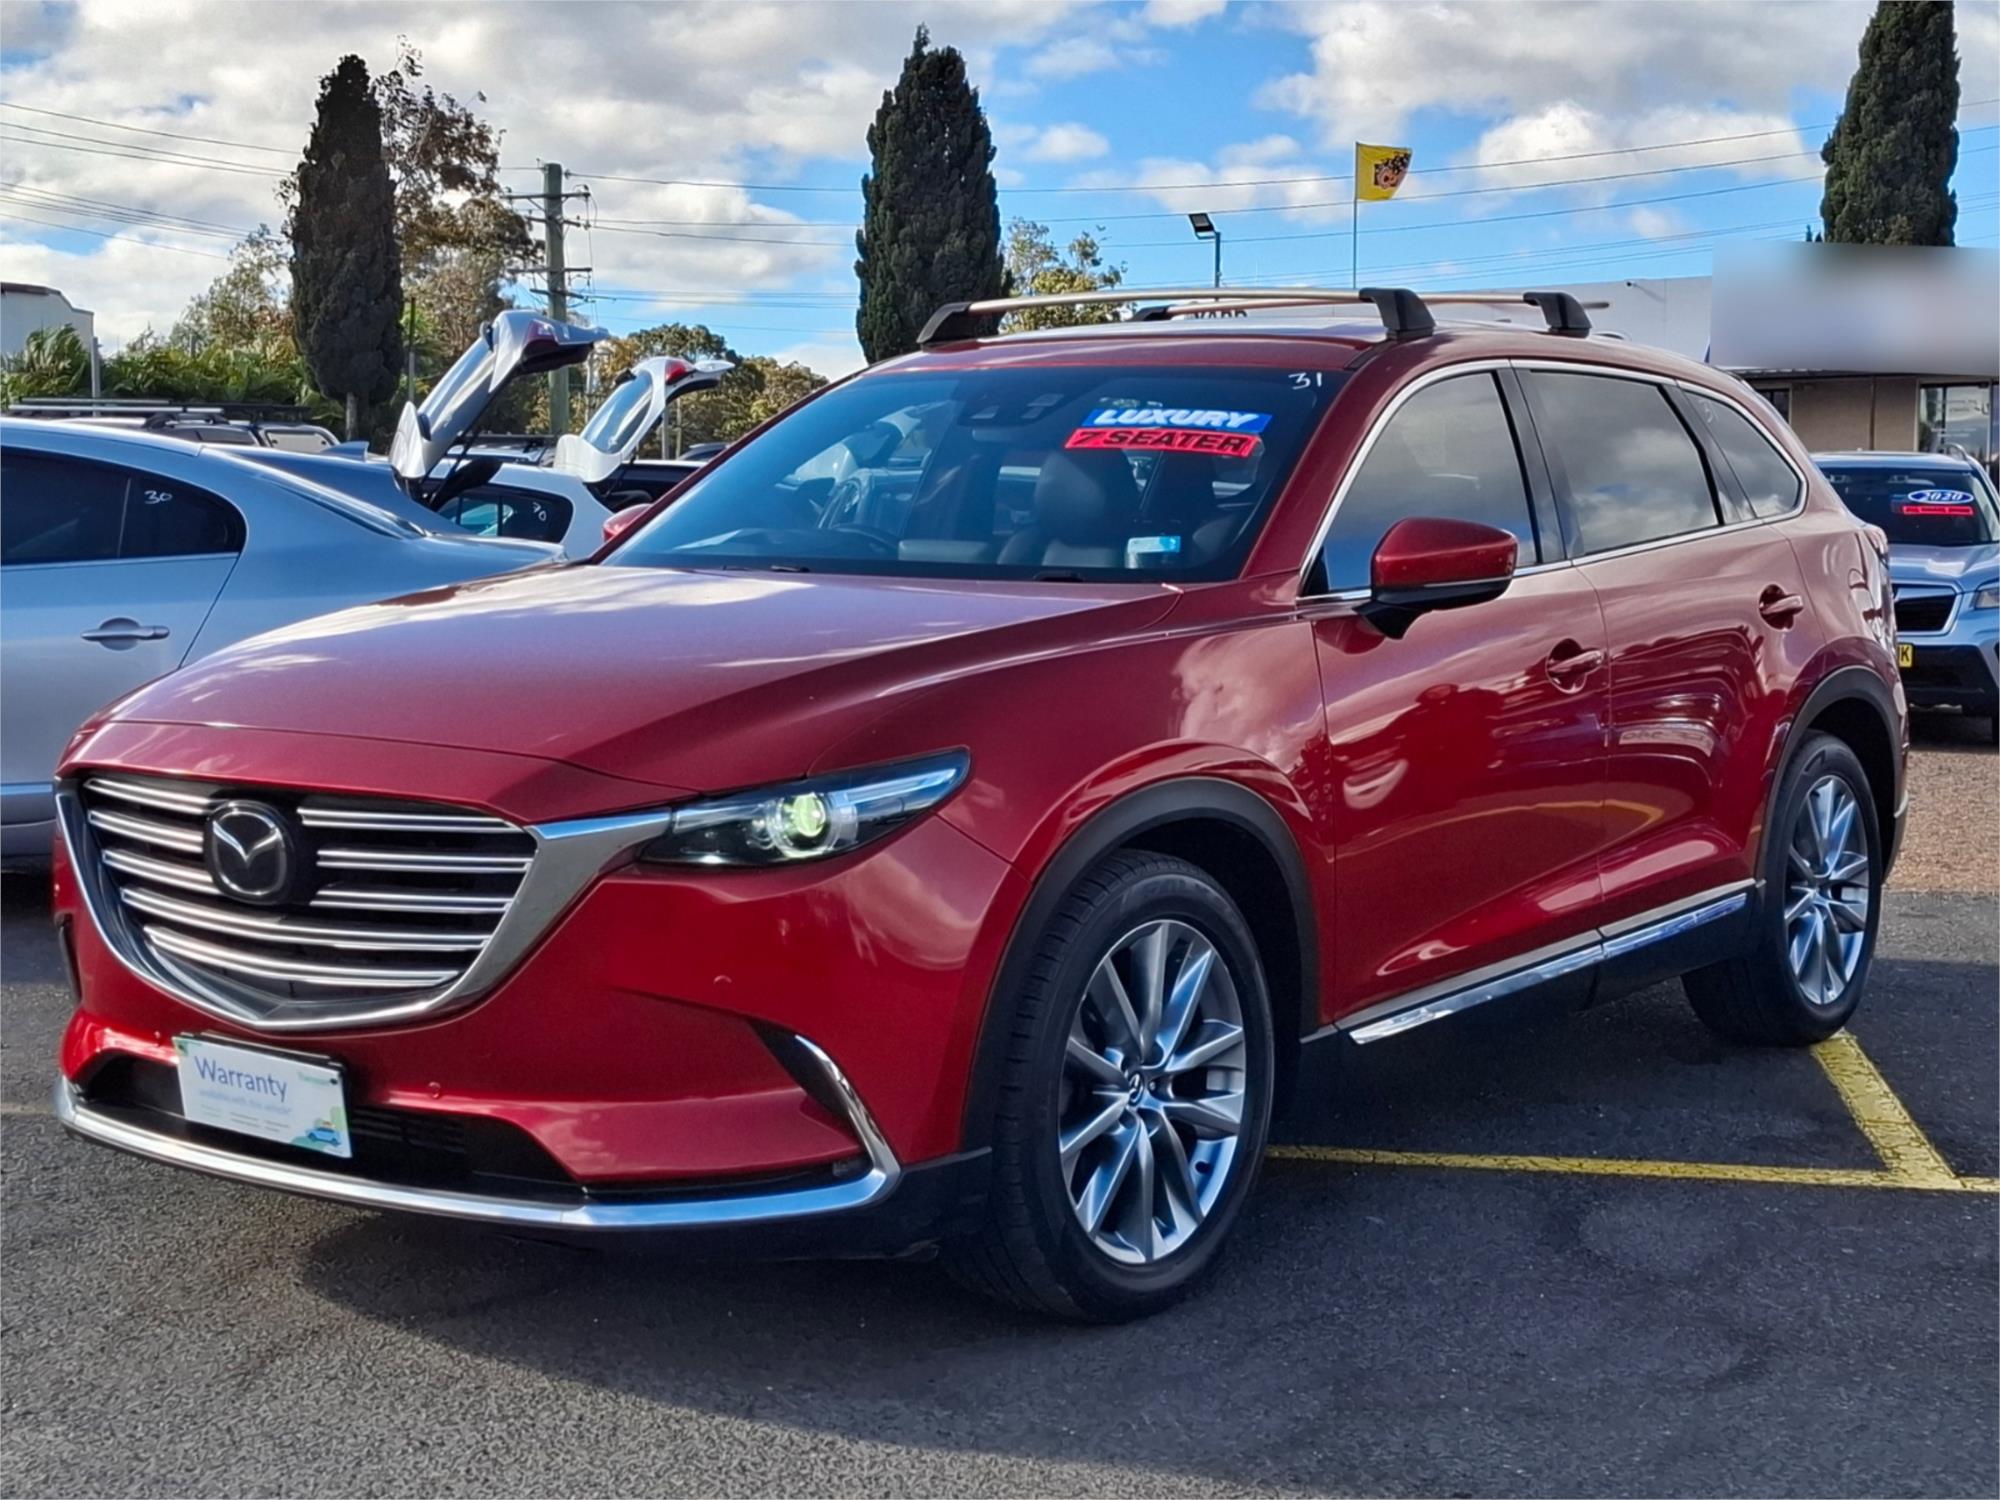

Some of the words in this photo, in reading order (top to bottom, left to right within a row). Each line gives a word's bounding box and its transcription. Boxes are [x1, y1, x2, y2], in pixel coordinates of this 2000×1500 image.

[1288, 372, 1322, 390] 31
[1093, 409, 1259, 428] LUXURY
[1072, 430, 1102, 446] 7
[1103, 430, 1250, 452] SEATER
[144, 490, 173, 504] 30
[194, 1055, 288, 1103] Warranty
